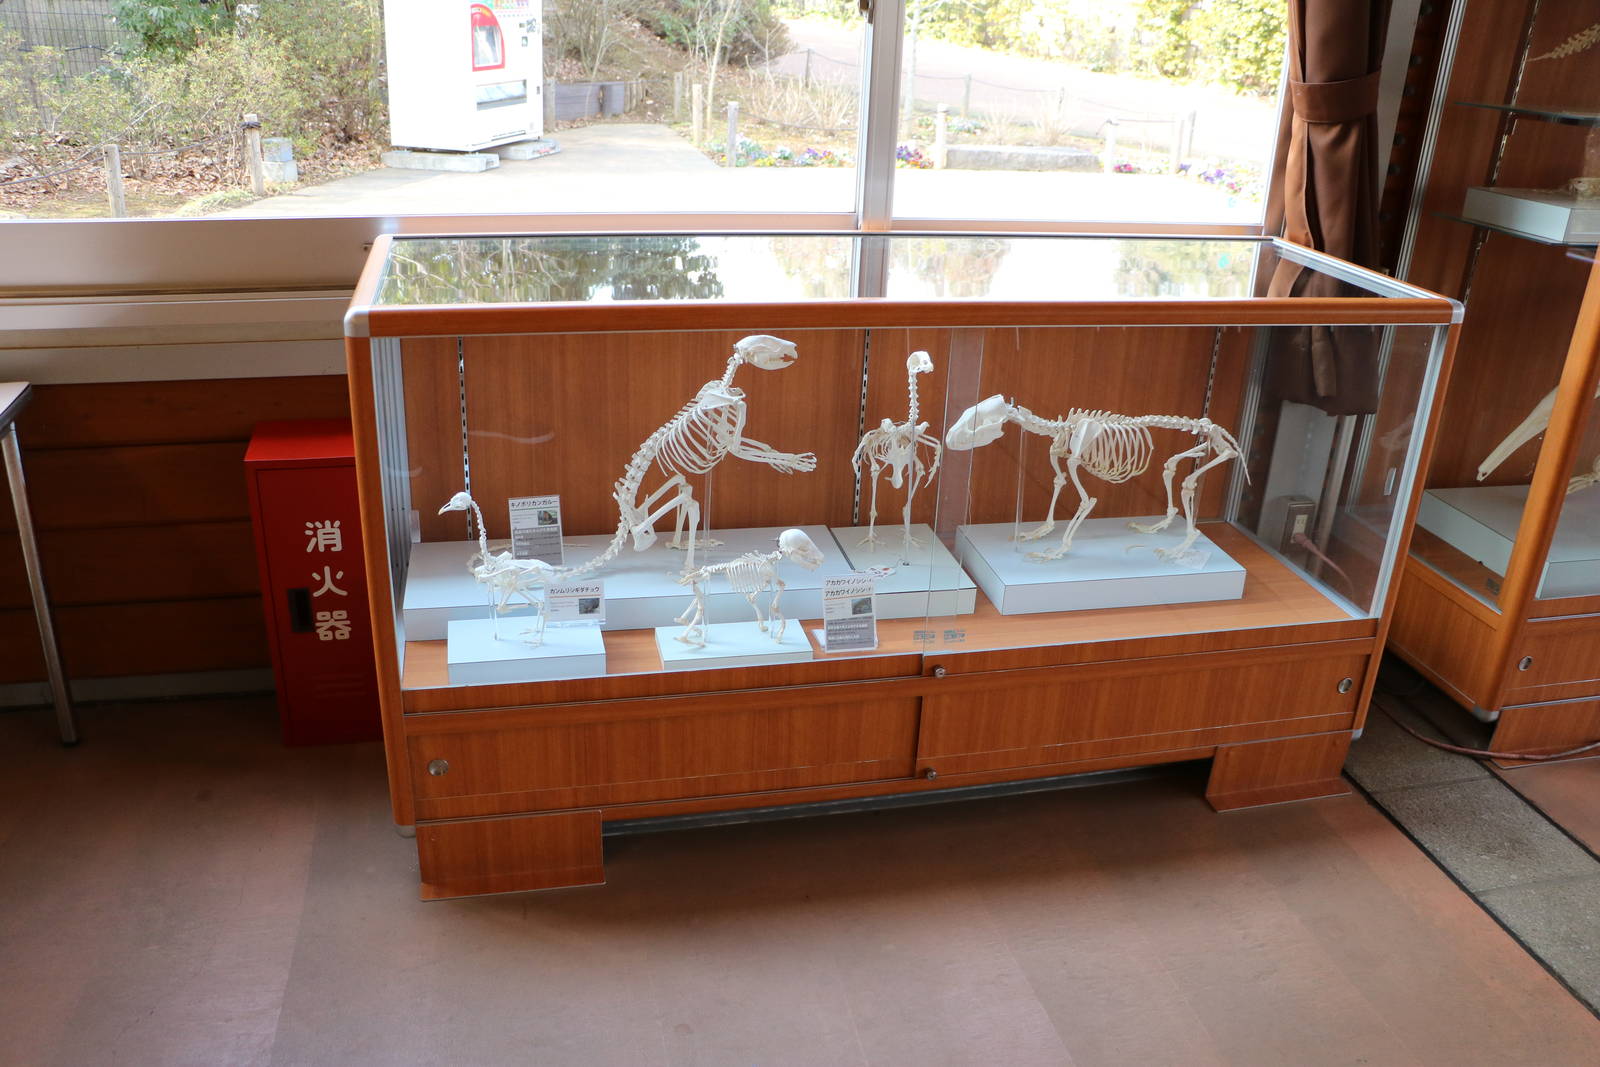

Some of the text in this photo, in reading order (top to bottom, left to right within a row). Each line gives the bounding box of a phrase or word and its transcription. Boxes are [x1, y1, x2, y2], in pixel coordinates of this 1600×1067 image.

[511, 499, 558, 508] キノボリカンガルー
[304, 519, 352, 641] 消火器
